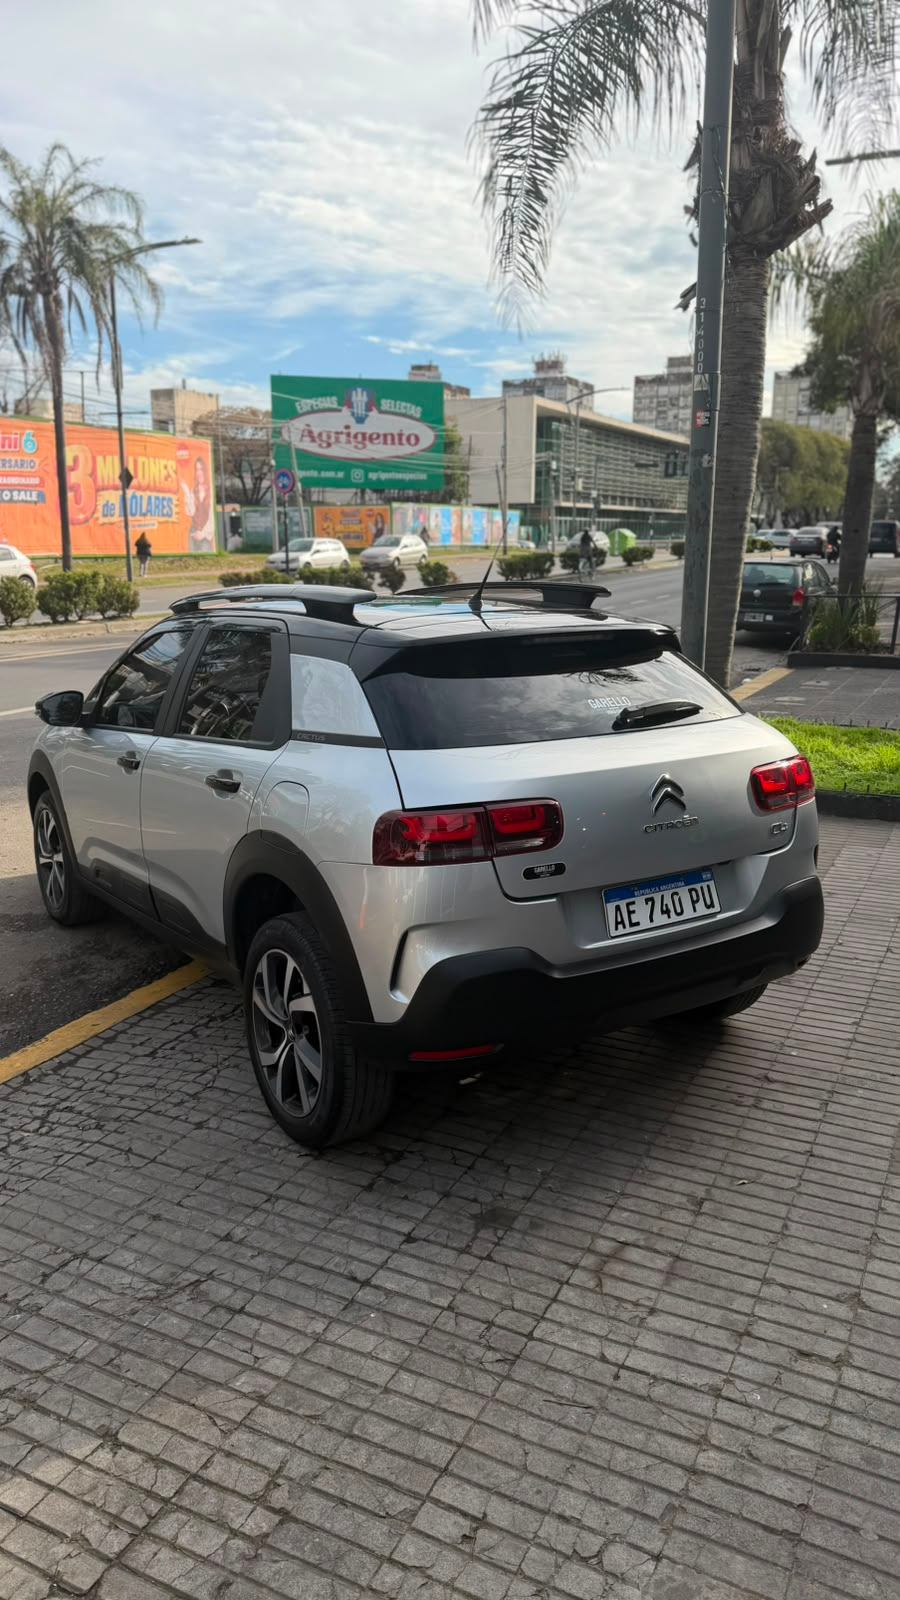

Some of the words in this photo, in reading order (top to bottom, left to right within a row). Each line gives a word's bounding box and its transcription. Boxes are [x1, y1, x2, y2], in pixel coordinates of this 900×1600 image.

[380, 398, 423, 418] SELECTAS
[23, 431, 37, 453] 6
[299, 424, 421, 450] Agrigento
[96, 456, 177, 488] MILONES
[66, 445, 96, 524] 3
[12, 490, 38, 502] SALE
[102, 500, 116, 518] de
[643, 814, 700, 833] CITROËN
[614, 901, 640, 931] AE
[644, 891, 684, 923] 740
[688, 884, 715, 913] PU
